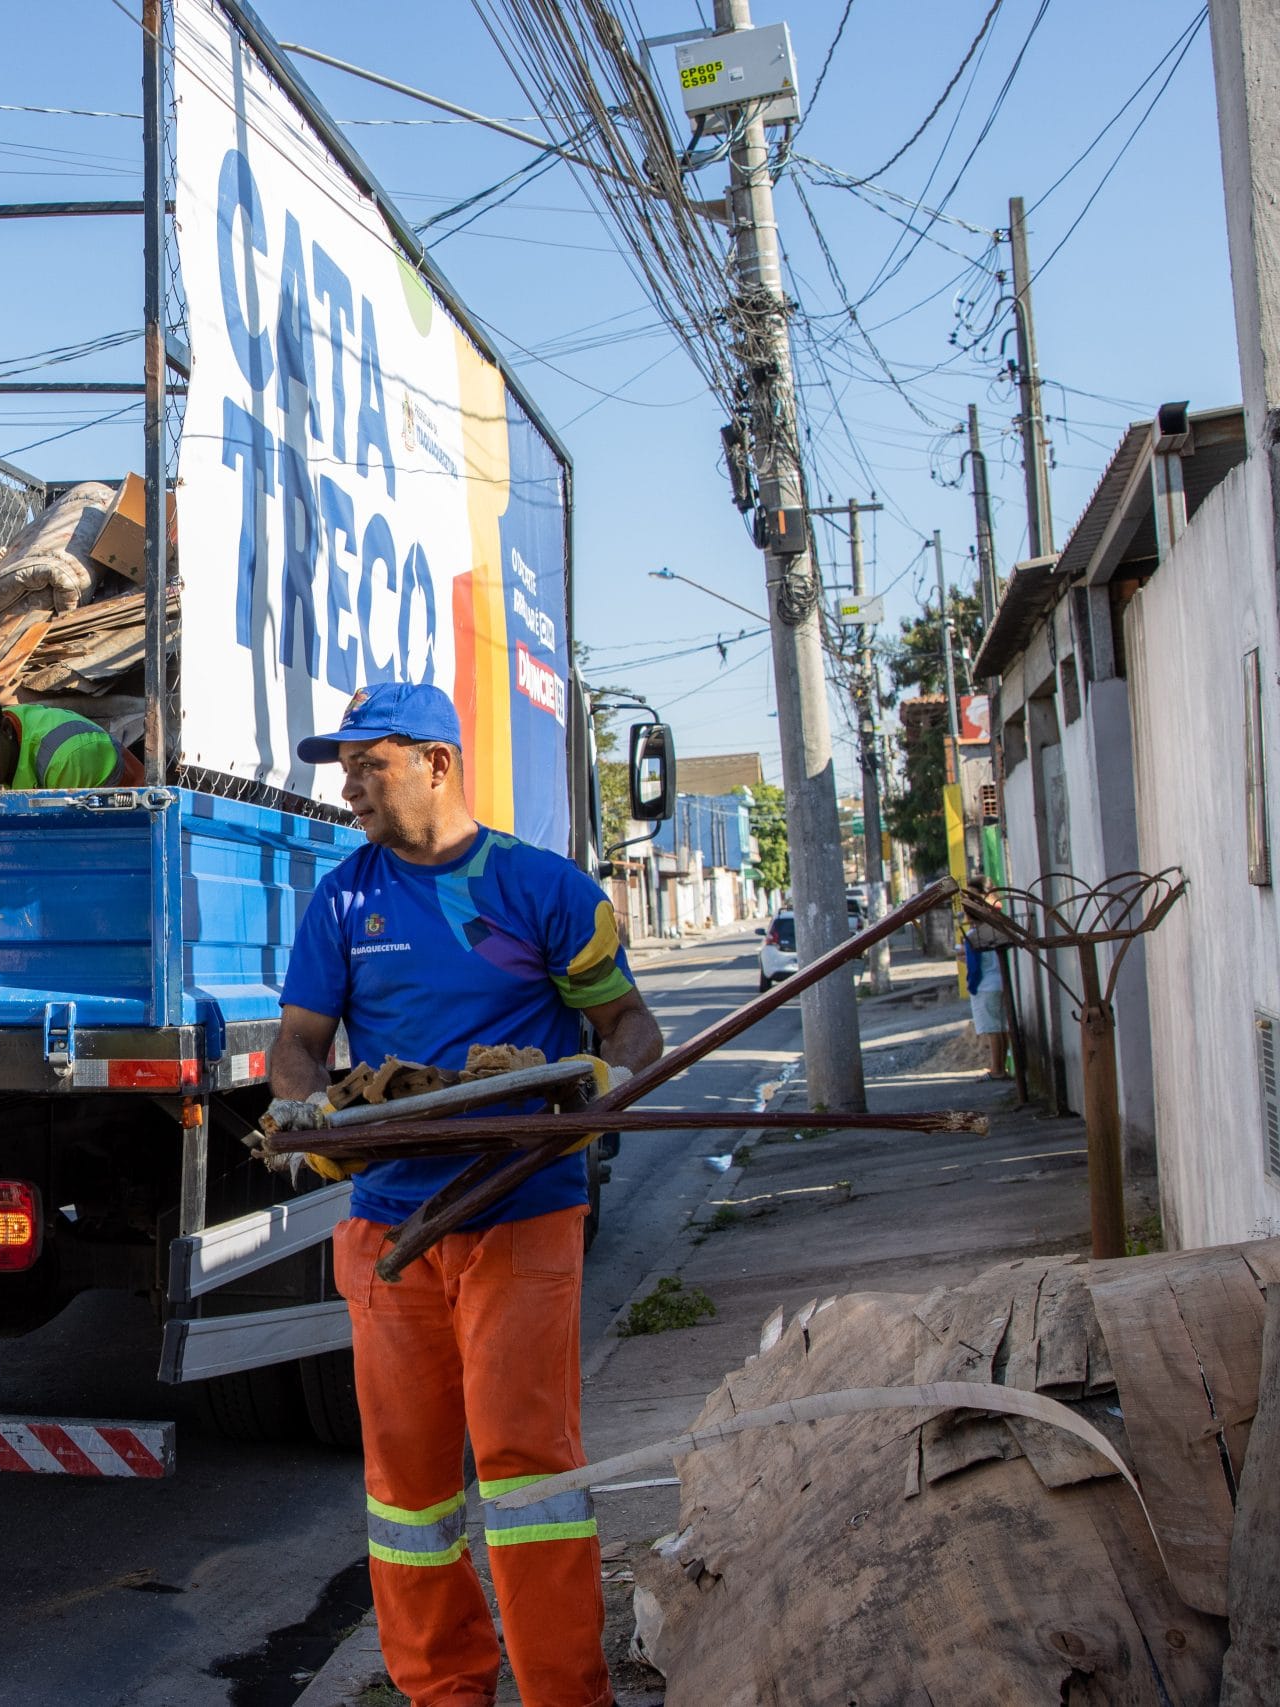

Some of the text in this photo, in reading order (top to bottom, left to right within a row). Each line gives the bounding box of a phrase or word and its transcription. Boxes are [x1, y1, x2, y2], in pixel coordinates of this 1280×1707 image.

[681, 61, 723, 78] CP605
[682, 73, 716, 89] CS99
[217, 148, 396, 501] CATA
[222, 396, 437, 696] TRECO
[351, 943, 411, 955] QUAQUECETUBA
